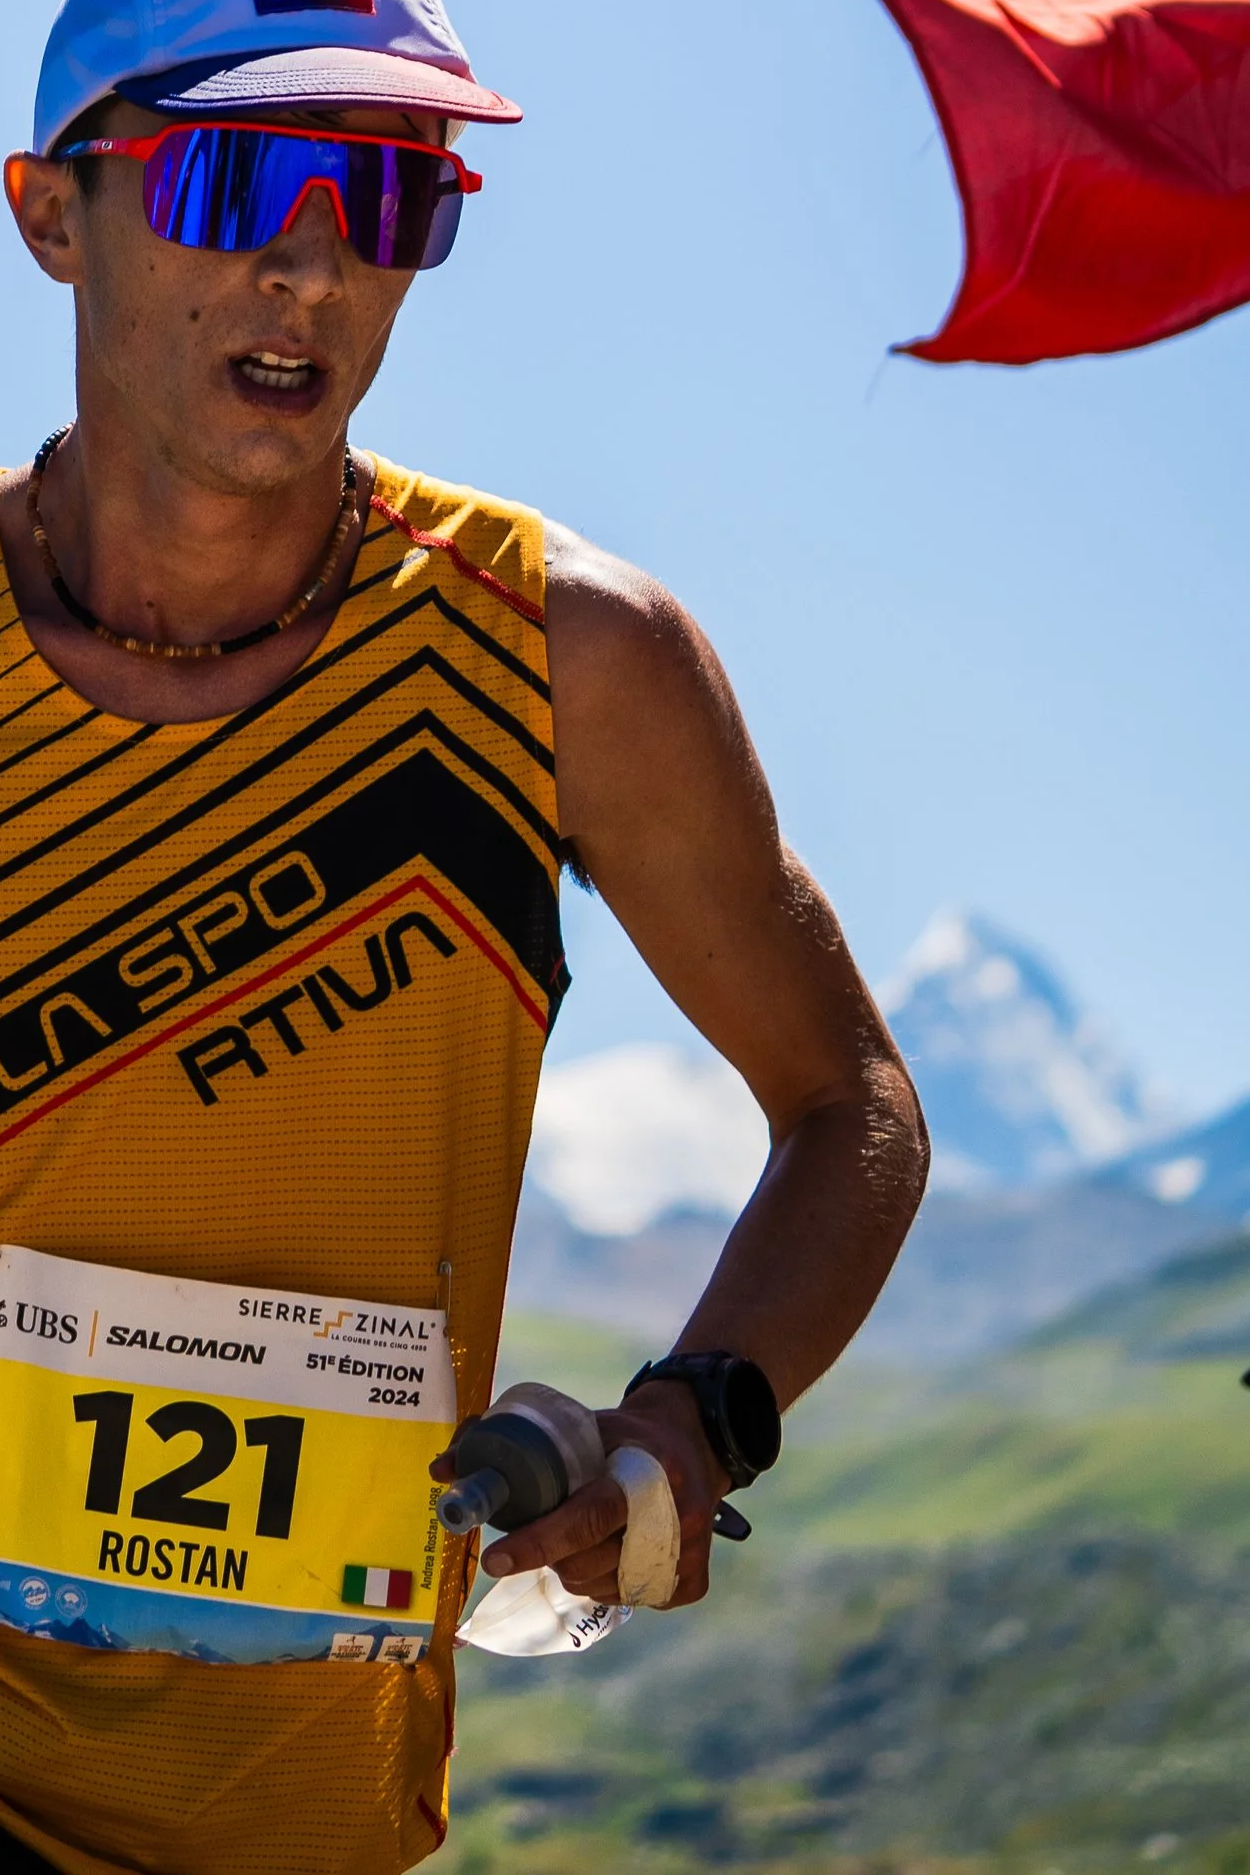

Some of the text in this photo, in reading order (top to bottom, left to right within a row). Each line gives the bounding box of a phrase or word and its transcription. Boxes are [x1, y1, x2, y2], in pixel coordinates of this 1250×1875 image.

[118, 850, 327, 1014] SPO
[176, 910, 458, 1107] RTIVA
[15, 1301, 78, 1344] UBS
[238, 1298, 430, 1340] SIERRE ZINAL
[106, 1325, 267, 1365] SALOMON
[331, 1333, 340, 1341] LA
[342, 1335, 371, 1345] COURSE
[373, 1340, 387, 1348] DES
[390, 1342, 408, 1350] CINQ
[338, 1354, 425, 1384] ÉDITION
[368, 1387, 421, 1407] 2024
[72, 1390, 306, 1540] 121
[424, 1518, 439, 1554] Rostan
[97, 1529, 250, 1592] ROSTAN
[420, 1555, 435, 1591] Andrea
